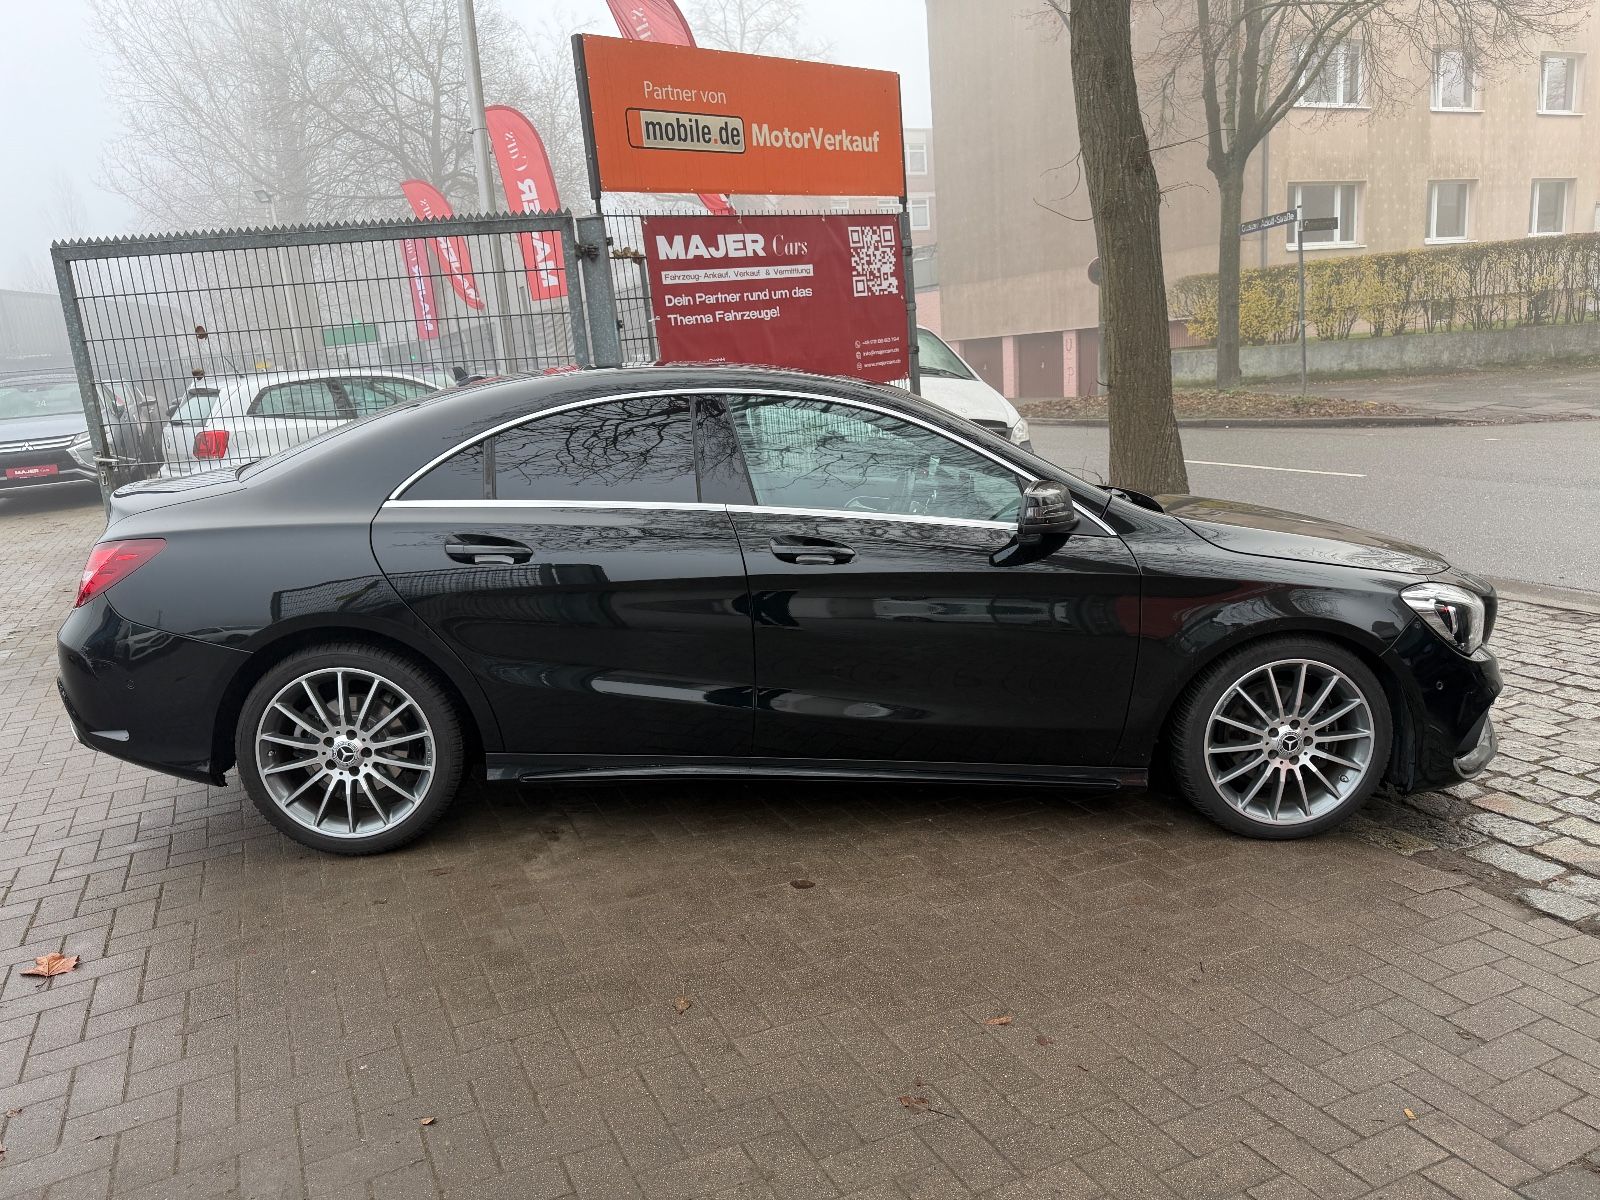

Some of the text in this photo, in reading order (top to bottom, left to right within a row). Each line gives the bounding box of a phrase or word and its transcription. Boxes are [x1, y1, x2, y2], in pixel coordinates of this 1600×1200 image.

[643, 80, 727, 104] Partner von
[644, 117, 880, 153] mobile.de MotorVerkauf
[655, 233, 808, 261] MAJER Cars
[733, 269, 761, 278] Verkauf
[765, 268, 772, 276] &
[773, 266, 811, 276] Vermittlung
[664, 286, 813, 307] Dein Partner rund um das
[667, 305, 781, 327] Thema Fahrzeuge!
